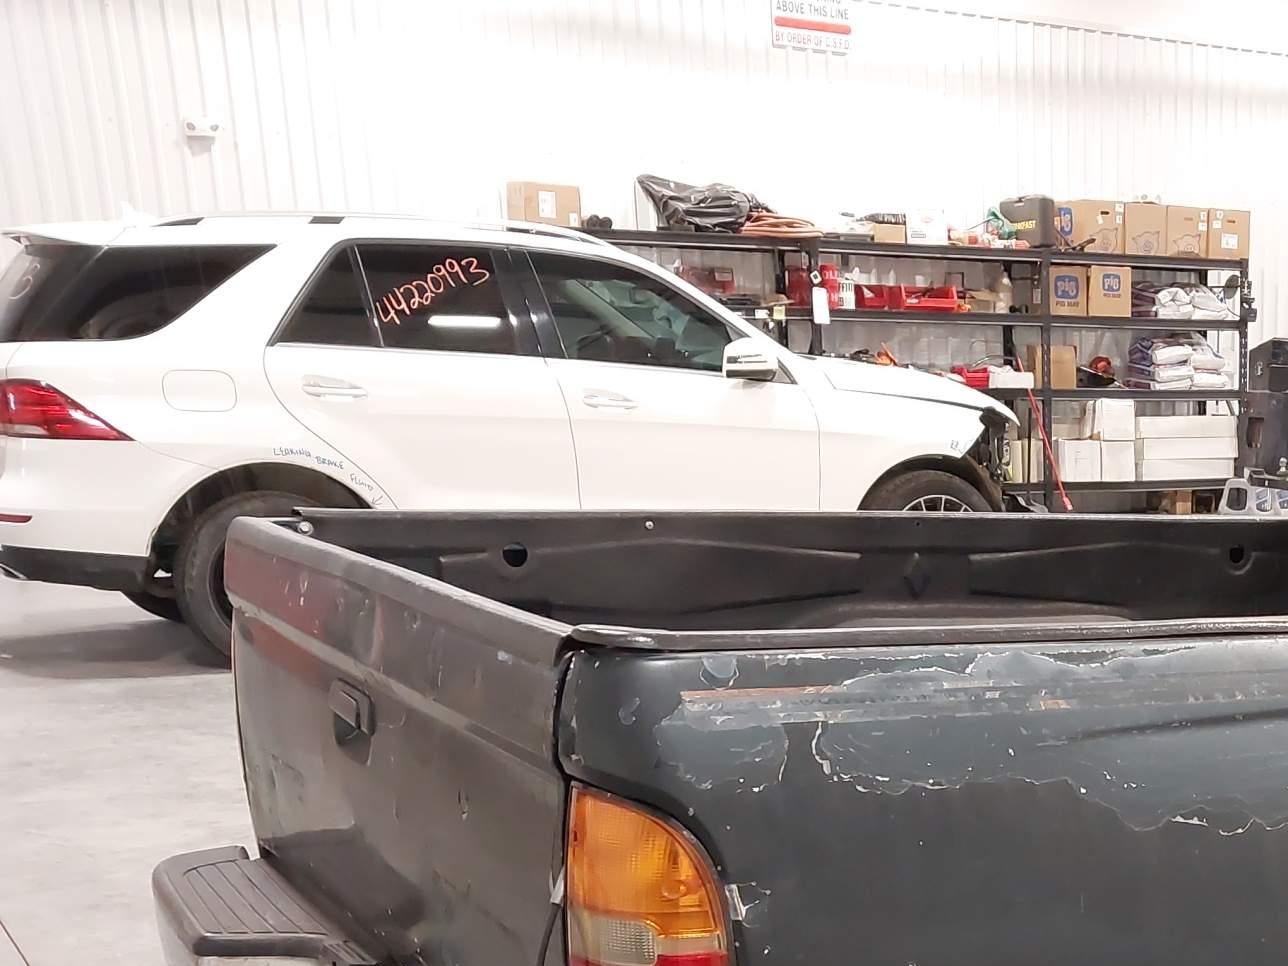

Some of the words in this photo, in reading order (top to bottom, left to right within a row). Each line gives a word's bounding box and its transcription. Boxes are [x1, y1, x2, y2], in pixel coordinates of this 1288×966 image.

[776, 0, 804, 14] ABOVE
[808, 4, 827, 17] THIS
[831, 7, 849, 20] LINE
[775, 30, 785, 42] BY
[376, 258, 489, 324] 44220993
[315, 455, 345, 470] BRAKE
